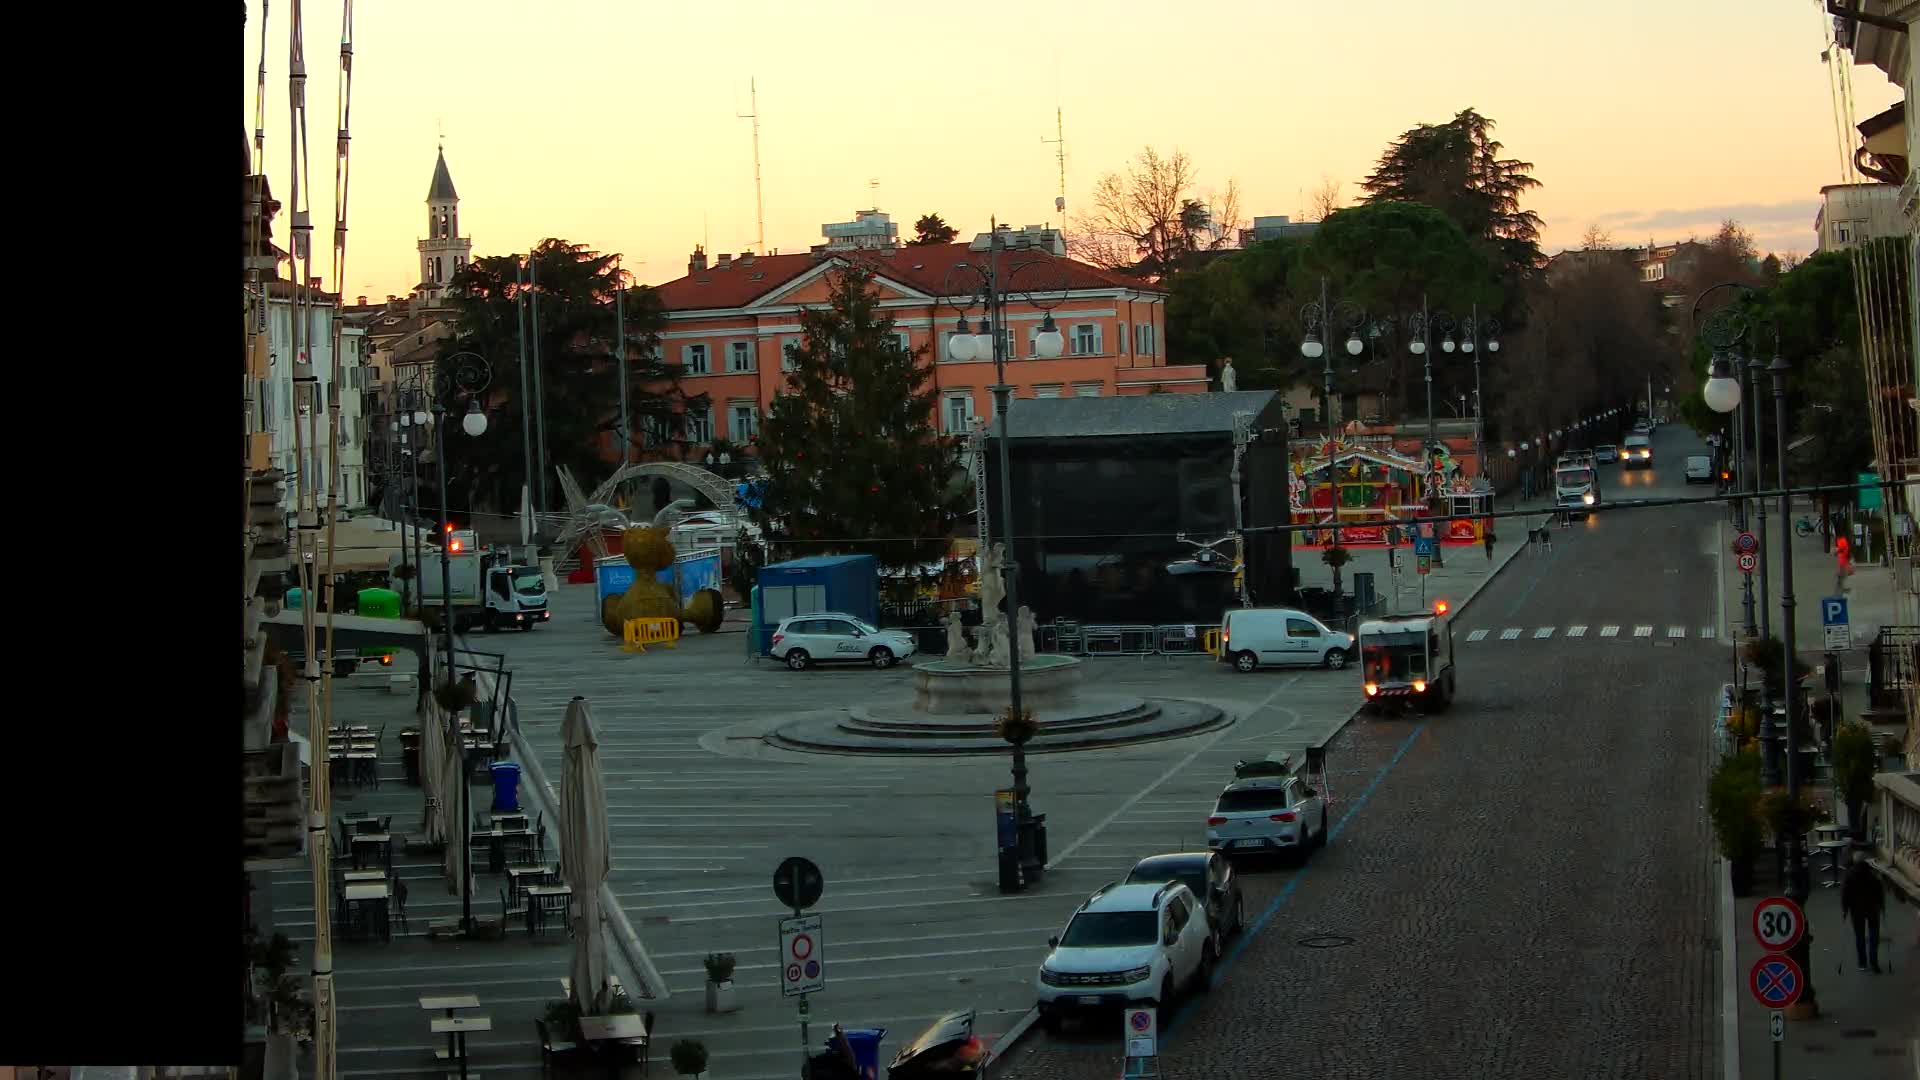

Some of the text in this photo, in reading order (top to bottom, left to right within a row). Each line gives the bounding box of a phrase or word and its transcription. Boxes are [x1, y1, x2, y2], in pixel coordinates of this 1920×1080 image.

[1742, 557, 1753, 567] 20
[1827, 602, 1842, 622] P
[1762, 911, 1792, 938] 30
